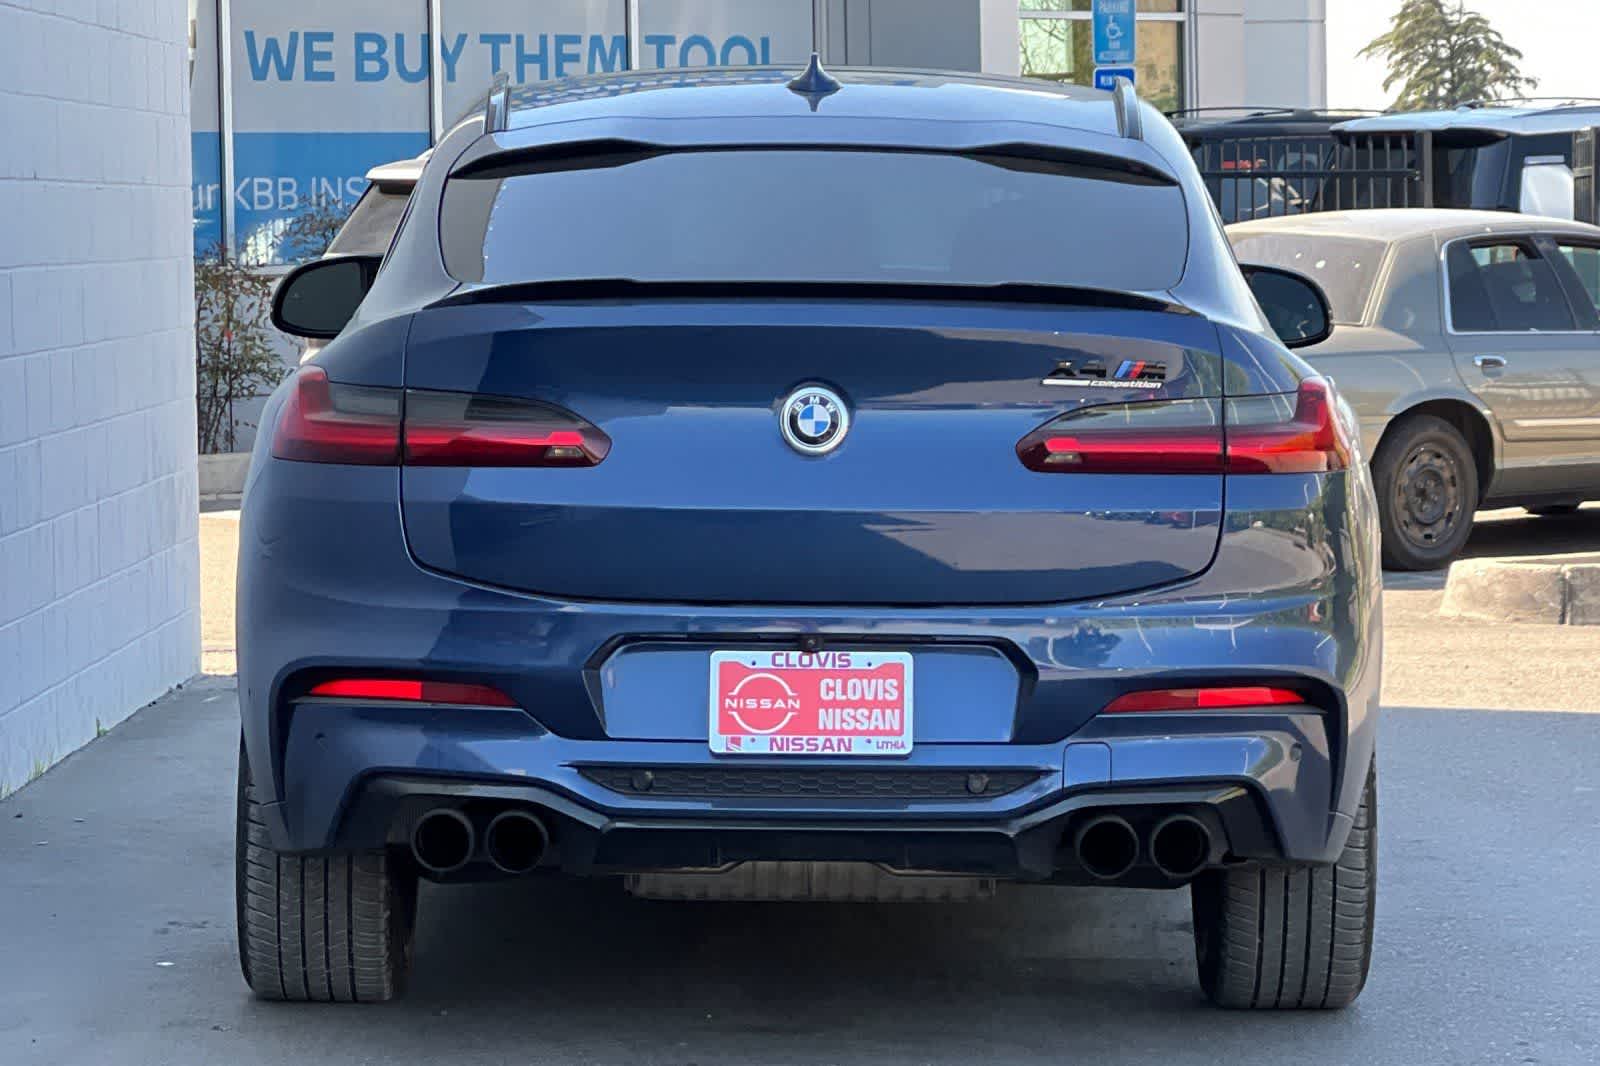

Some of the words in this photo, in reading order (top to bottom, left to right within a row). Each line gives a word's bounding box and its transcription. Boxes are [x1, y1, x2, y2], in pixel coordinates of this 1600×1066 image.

[244, 30, 335, 82] WE
[353, 32, 468, 83] BUY
[479, 33, 627, 84] THEM
[234, 177, 298, 210] KBB
[791, 395, 837, 413] BMW
[771, 652, 852, 668] CLOVIS
[820, 678, 899, 700] CLOVIS
[725, 698, 800, 709] NISSAN
[818, 708, 900, 731] NISSAN
[769, 737, 853, 752] NISSAN
[876, 740, 906, 750] LITHIA
